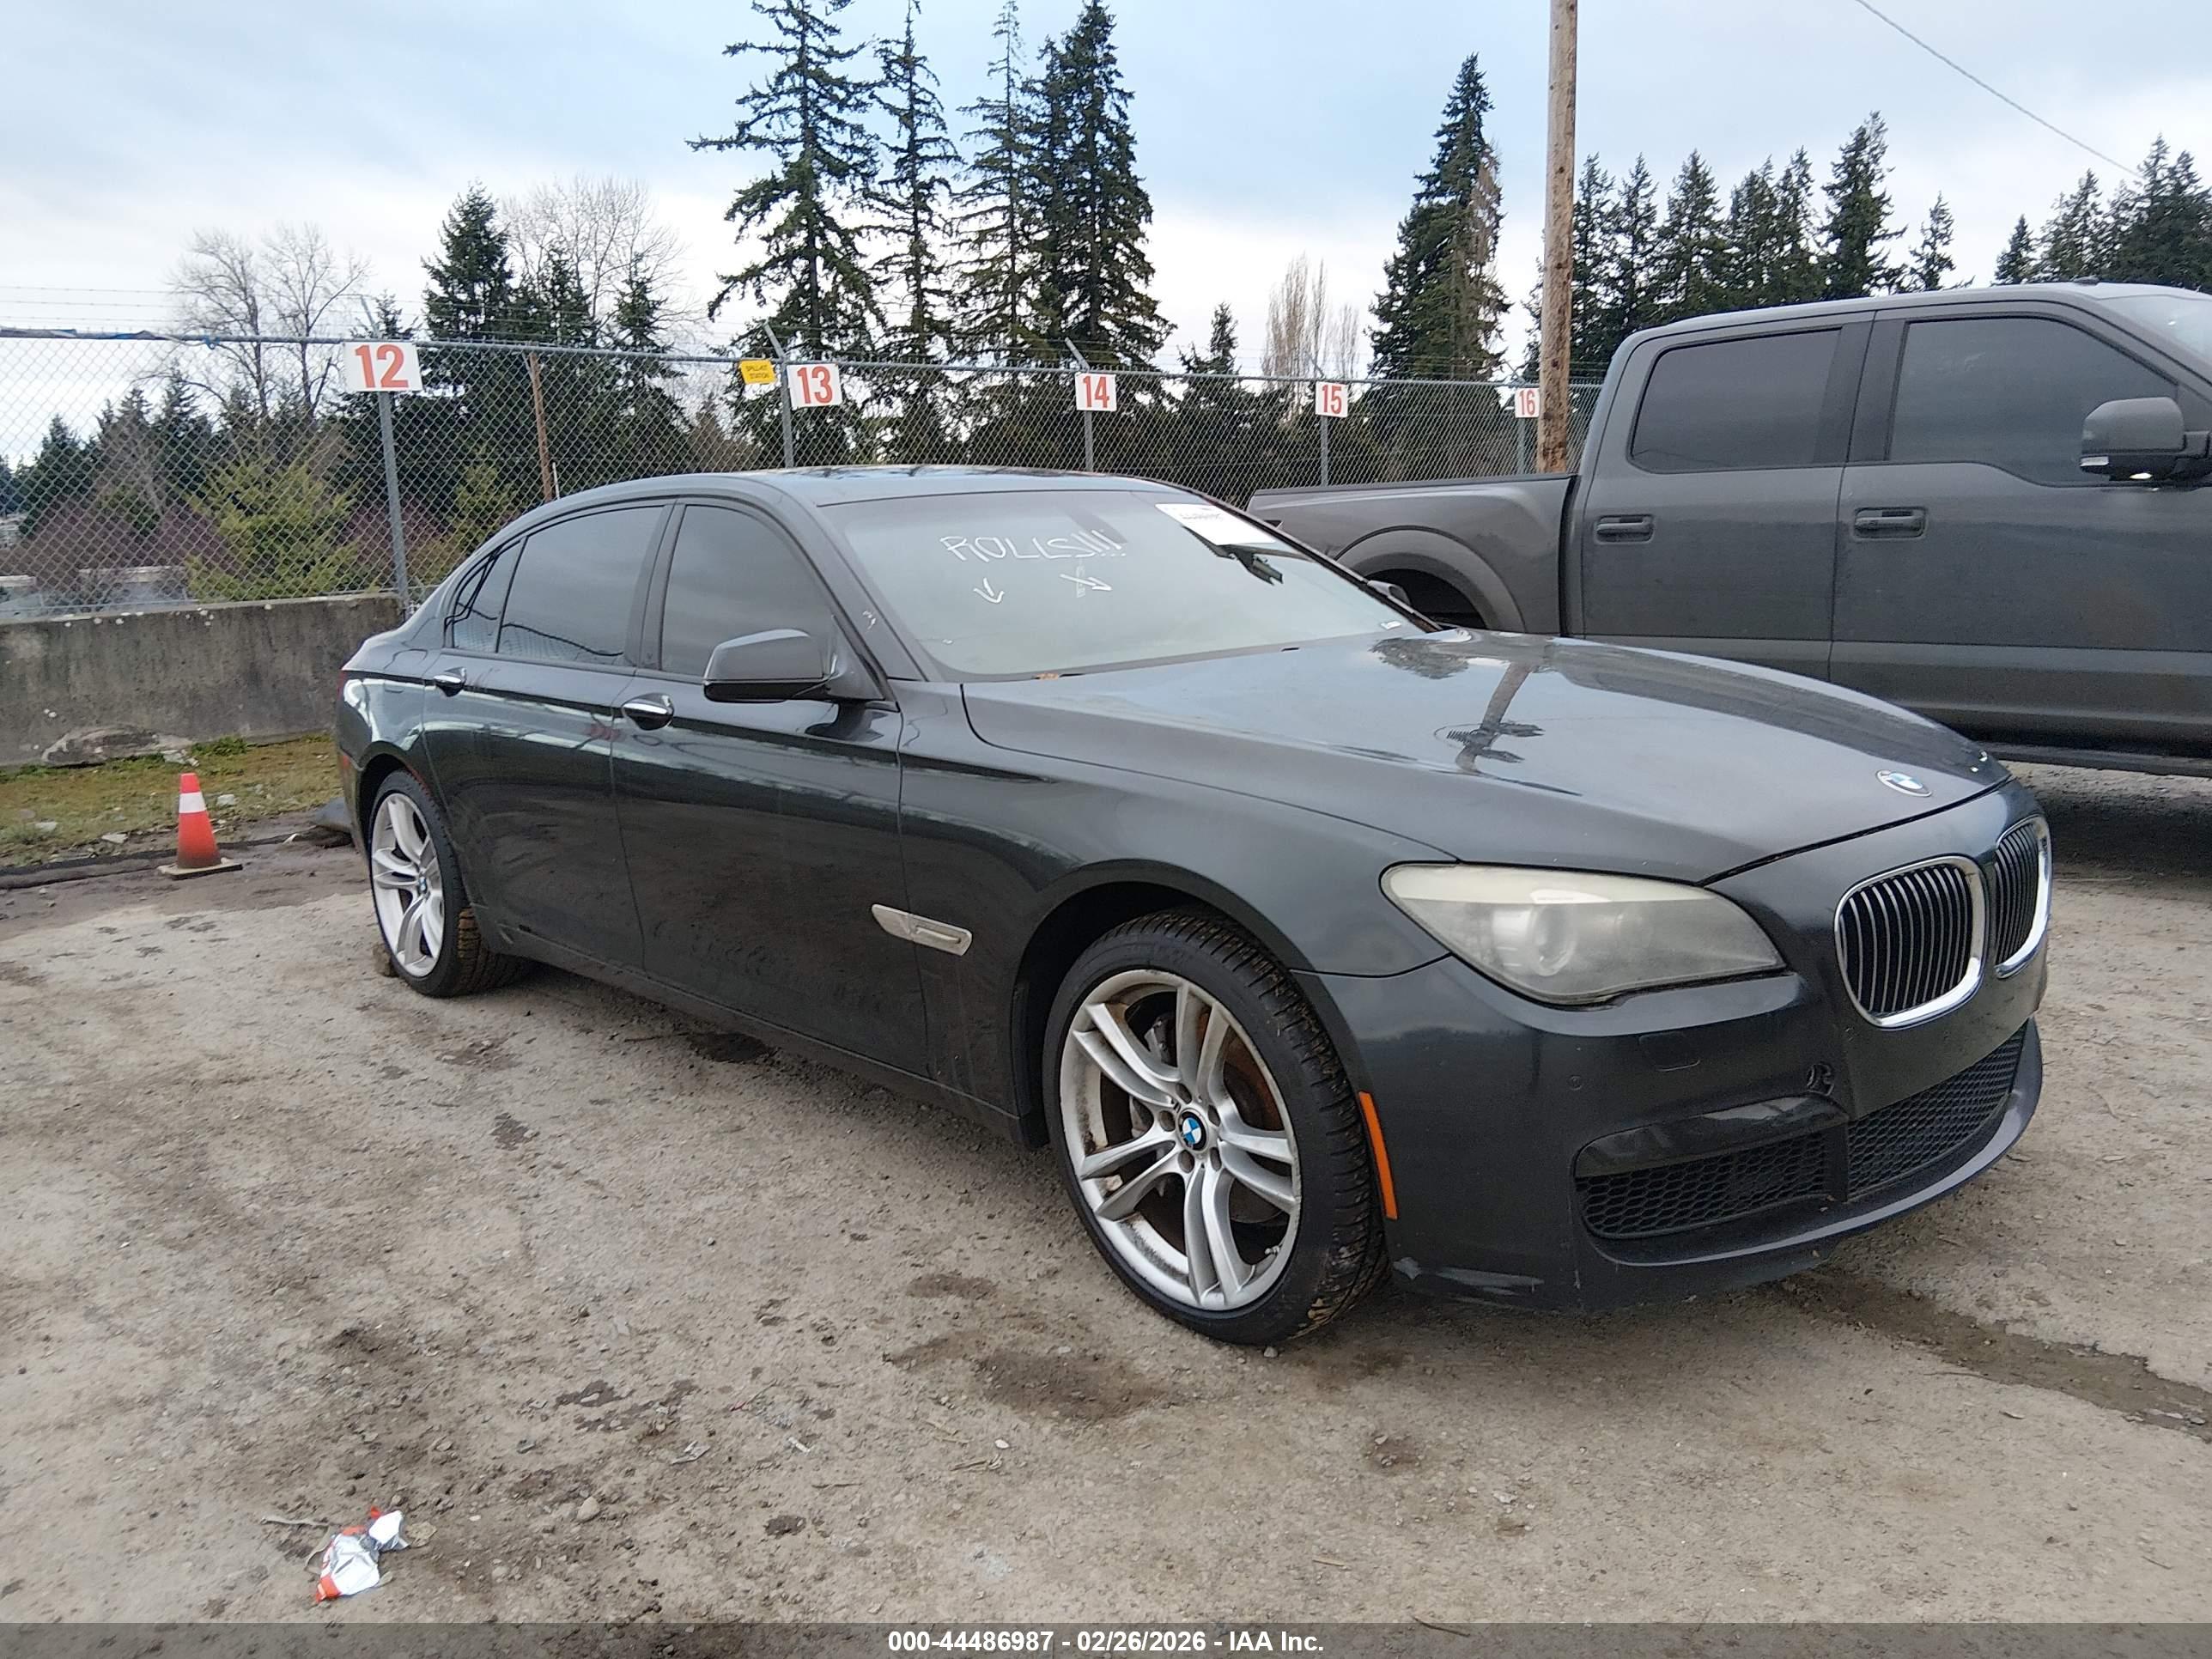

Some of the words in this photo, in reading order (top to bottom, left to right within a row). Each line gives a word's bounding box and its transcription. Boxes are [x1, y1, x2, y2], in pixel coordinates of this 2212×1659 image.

[355, 343, 410, 388] 12
[797, 366, 833, 404] 13
[1083, 375, 1109, 408] 14
[1322, 385, 1342, 414] 15
[1519, 390, 1535, 416] 16
